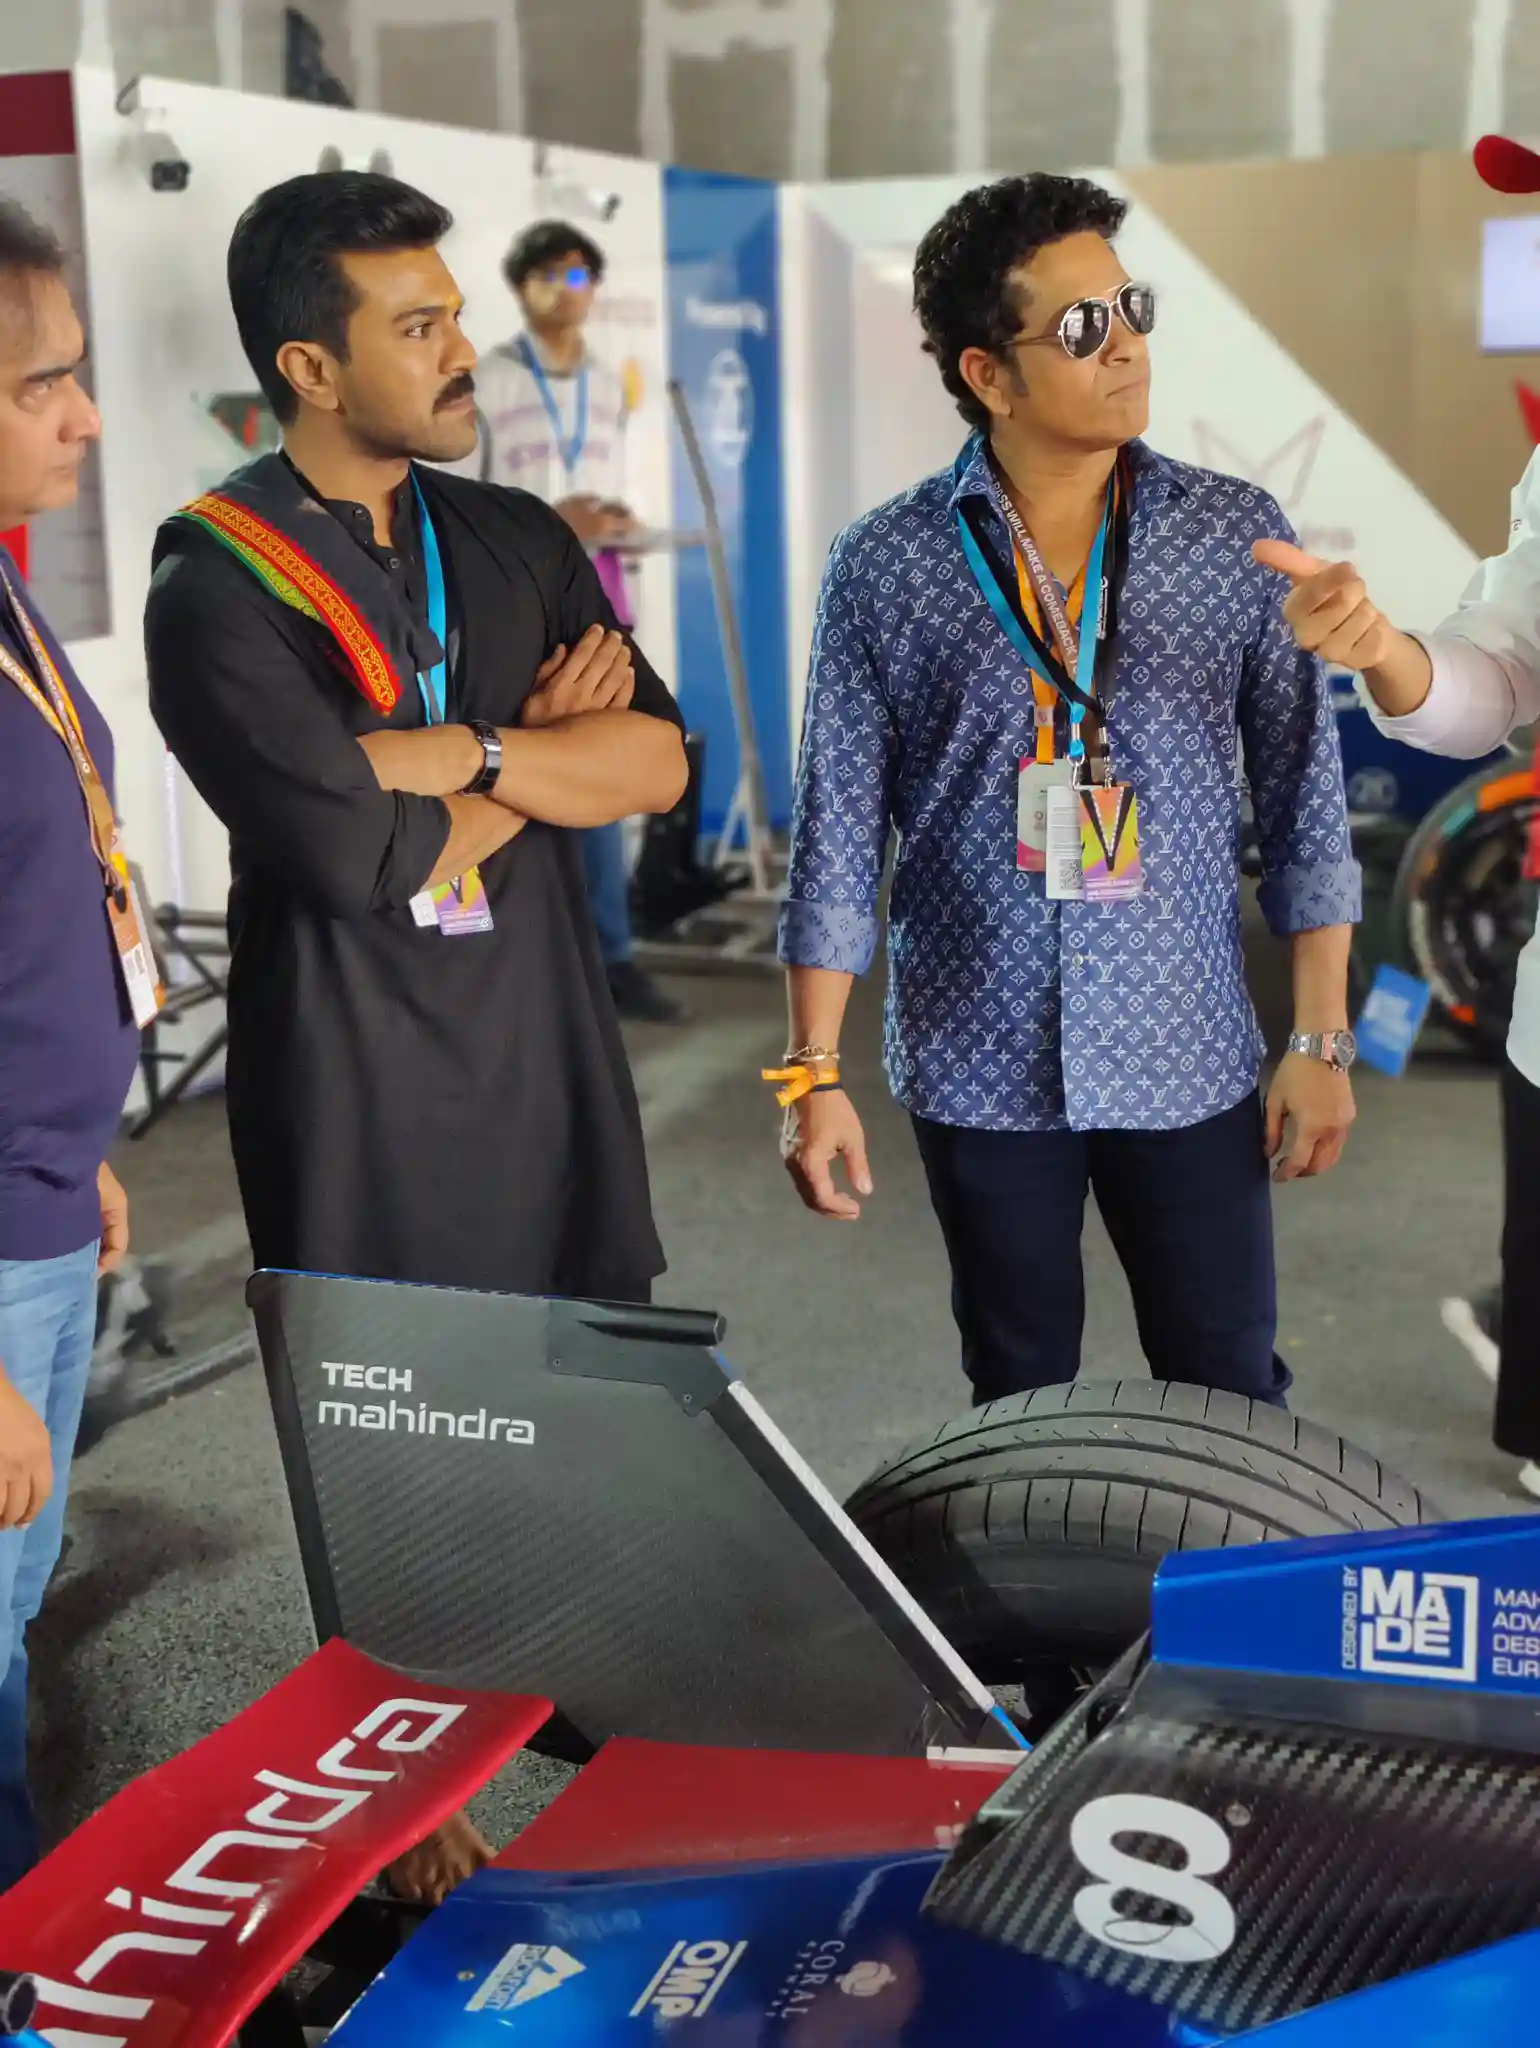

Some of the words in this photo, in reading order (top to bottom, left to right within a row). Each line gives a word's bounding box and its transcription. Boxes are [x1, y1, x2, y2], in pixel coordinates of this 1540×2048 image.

[1006, 509, 1027, 538] WILL
[1020, 537, 1044, 575] MAKE
[1036, 574, 1047, 585] A
[1041, 584, 1078, 656] COMEBACK
[321, 1361, 413, 1392] TECH
[318, 1400, 535, 1445] mahindra
[1342, 1565, 1359, 1588] BY
[1341, 1590, 1358, 1670] DESIGNED
[33, 1698, 468, 2048] hindra
[1070, 1793, 1236, 1962] 8
[651, 1940, 730, 2017] OMP
[780, 1940, 846, 2018] CORAL
